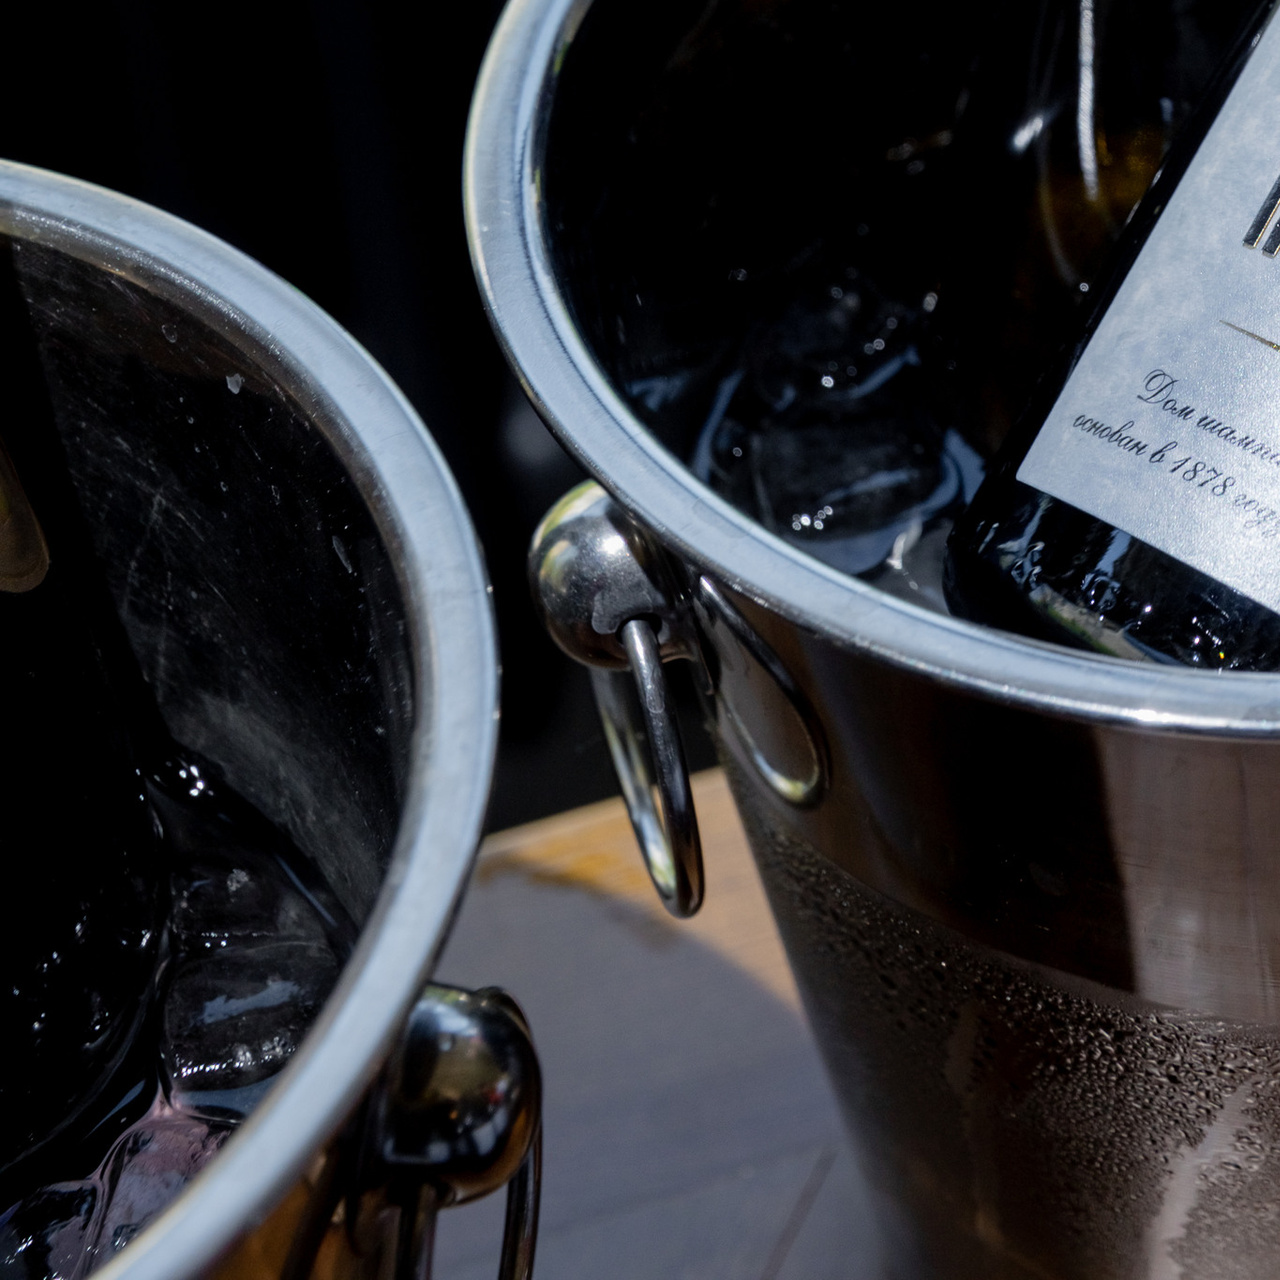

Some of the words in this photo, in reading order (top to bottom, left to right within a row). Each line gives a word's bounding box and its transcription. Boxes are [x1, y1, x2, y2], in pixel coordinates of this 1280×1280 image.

[1136, 368, 1195, 421] Дом
[1072, 413, 1149, 457] основан
[1149, 440, 1178, 464] в
[1170, 456, 1236, 497] 1878
